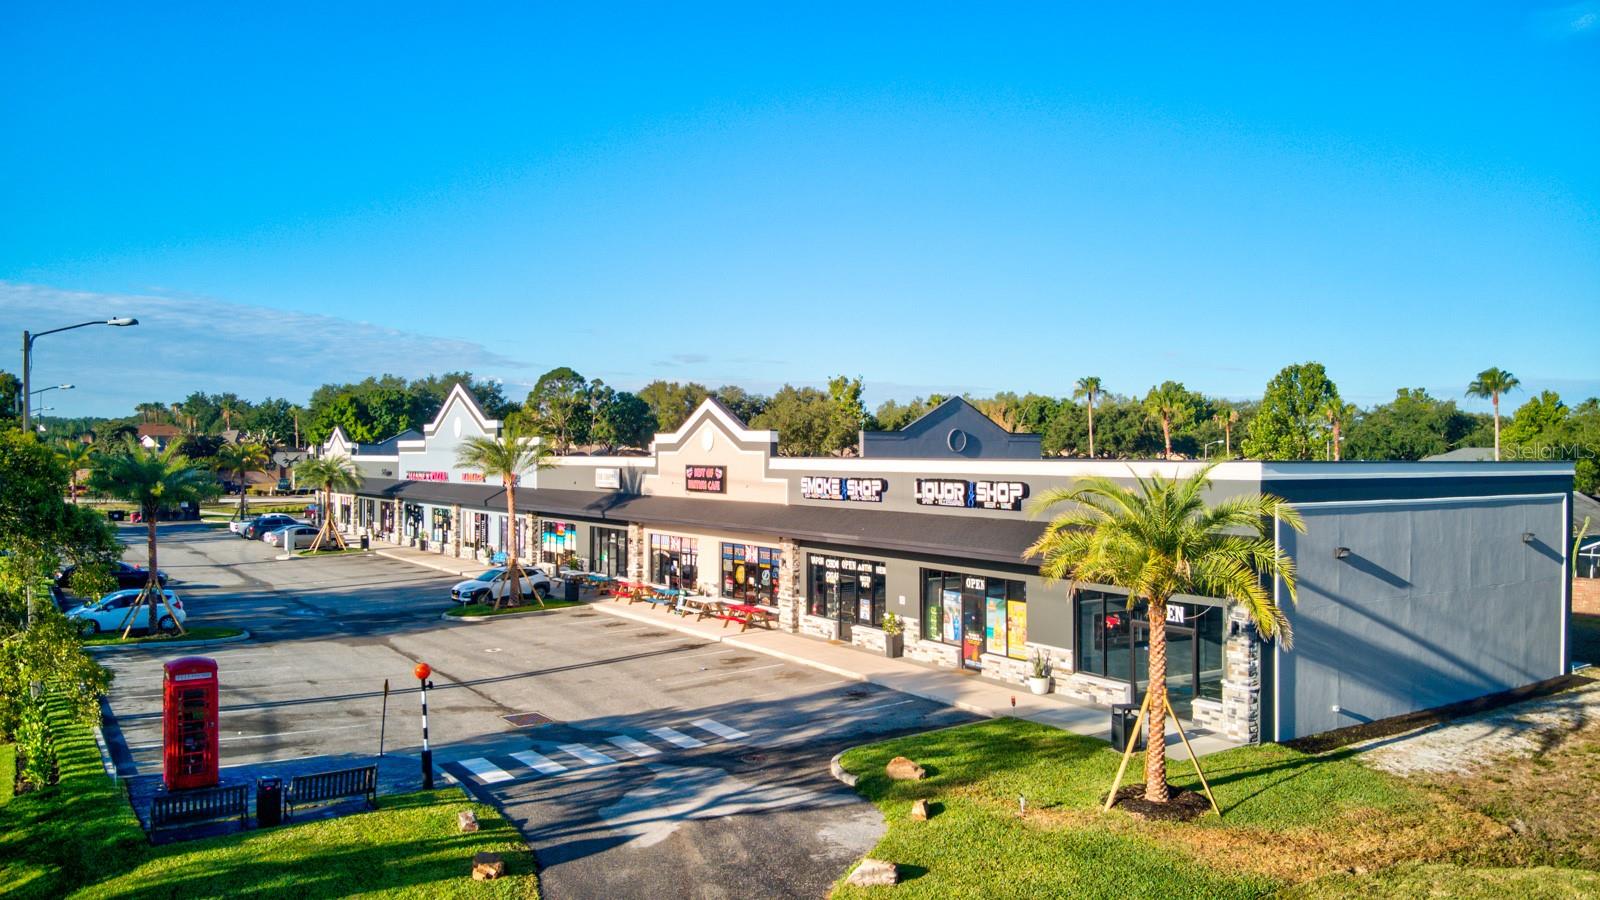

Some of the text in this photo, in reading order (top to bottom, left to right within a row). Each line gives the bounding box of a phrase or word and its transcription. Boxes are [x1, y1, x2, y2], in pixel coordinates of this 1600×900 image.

[800, 476, 882, 496] SMOKE SHOP
[913, 480, 1023, 503] LIQUOR SHOP
[841, 559, 857, 571] OPEN
[965, 578, 985, 590] OPEN
[1166, 604, 1184, 624] EN
